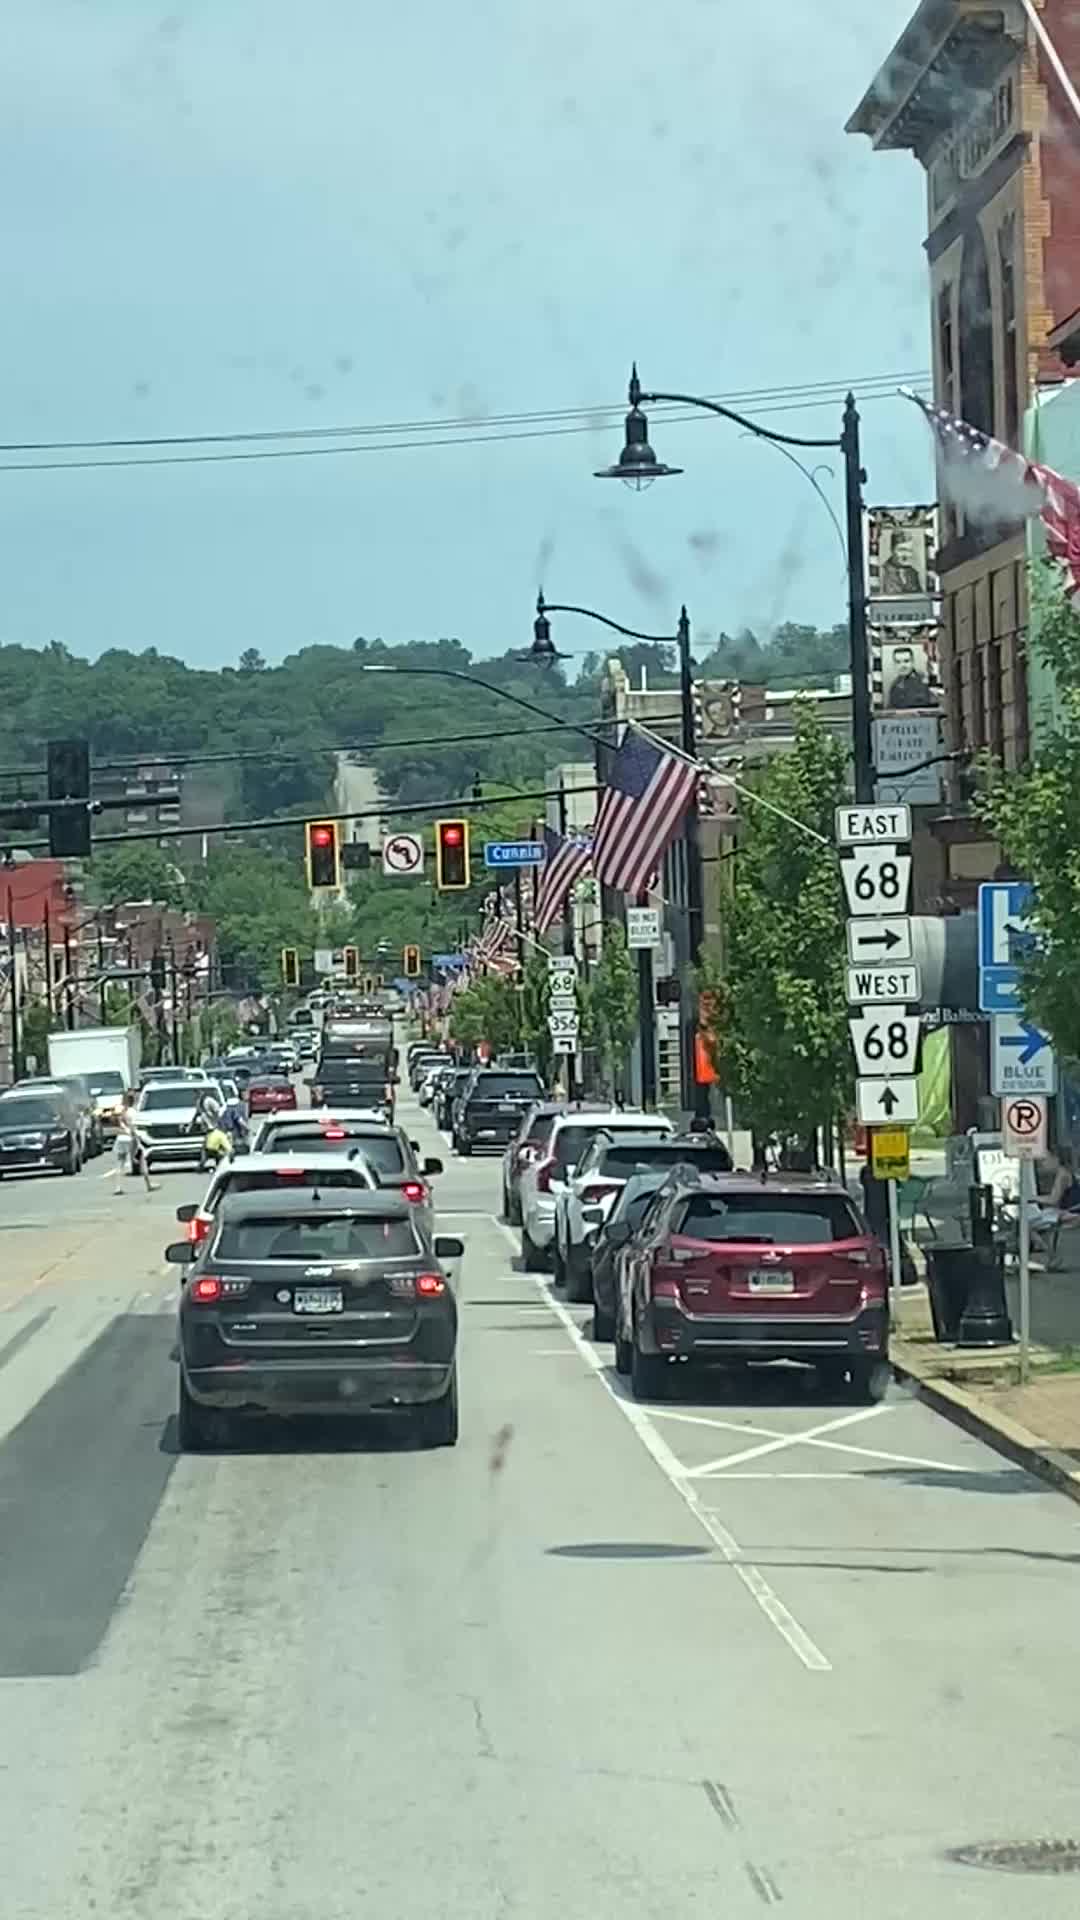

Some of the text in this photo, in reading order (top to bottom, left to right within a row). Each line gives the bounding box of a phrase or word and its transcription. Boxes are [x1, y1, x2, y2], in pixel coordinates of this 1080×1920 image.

[848, 813, 899, 836] EAST
[854, 862, 899, 900] 68
[551, 975, 572, 991] 68
[855, 972, 911, 996] WEST
[551, 1016, 577, 1032] 356
[863, 1021, 909, 1060] 68
[1003, 1065, 1046, 1079] BLUE
